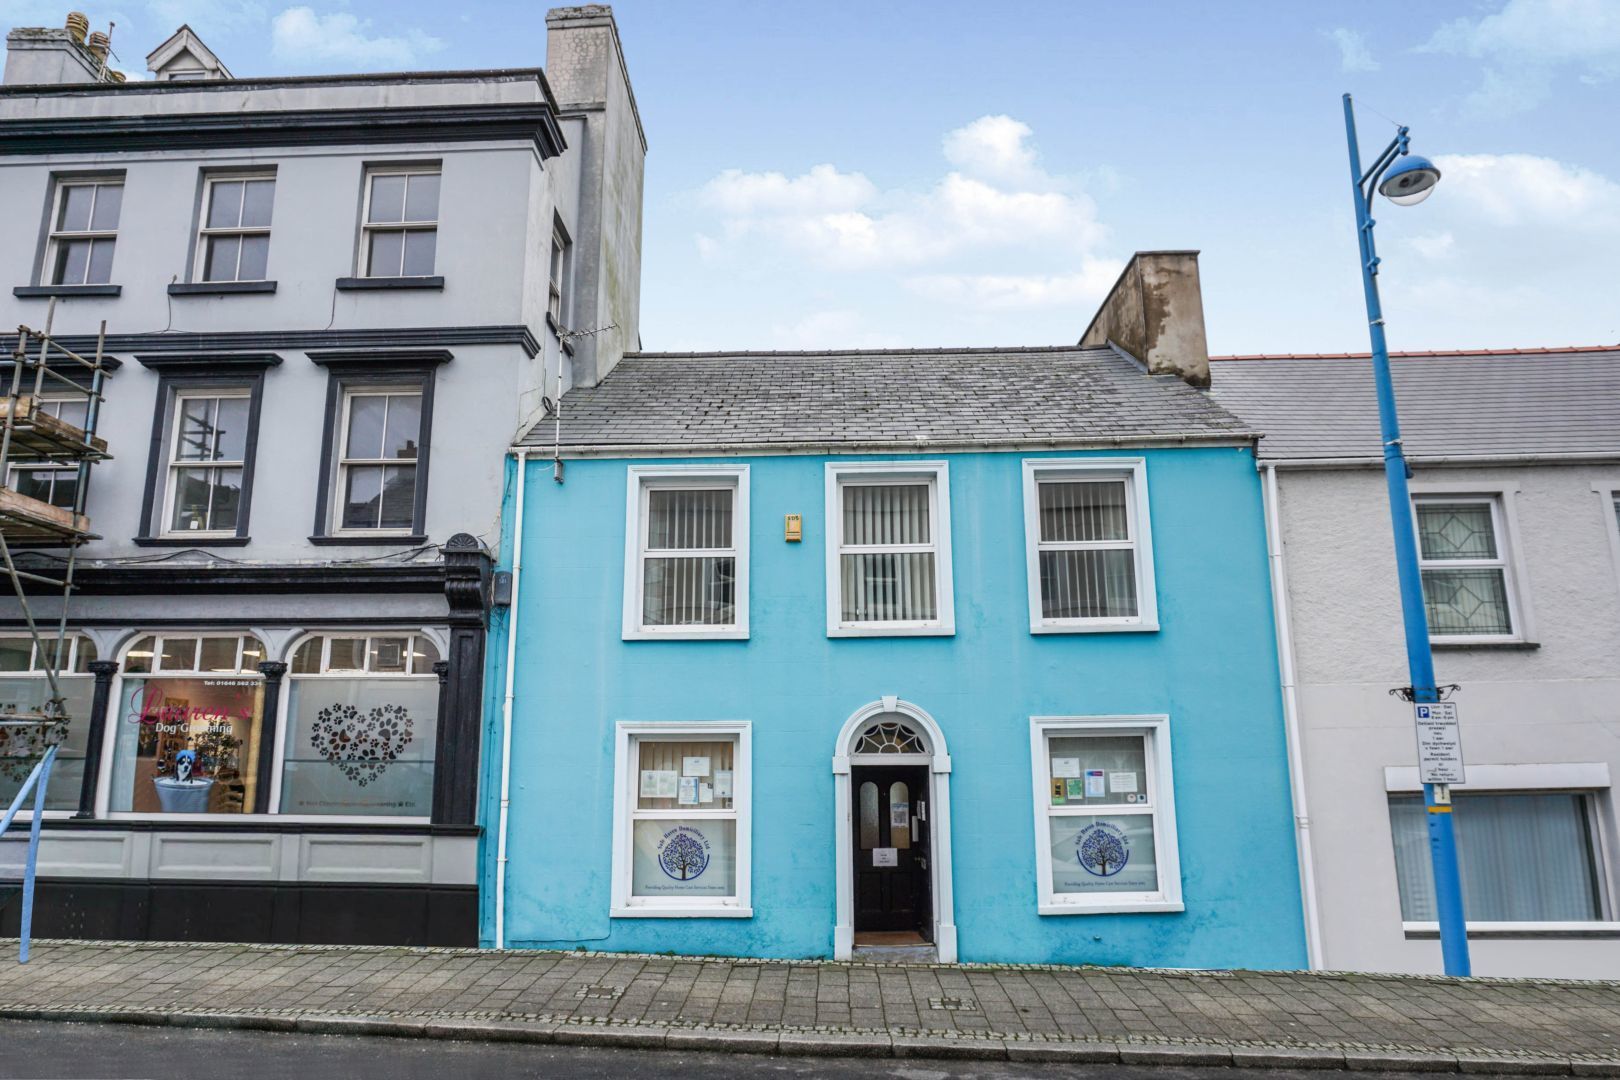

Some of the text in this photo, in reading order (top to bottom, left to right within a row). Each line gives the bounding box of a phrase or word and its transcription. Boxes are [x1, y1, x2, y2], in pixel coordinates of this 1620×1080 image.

[128, 684, 251, 724] Lauren's
[155, 722, 233, 735] Dog Gming
